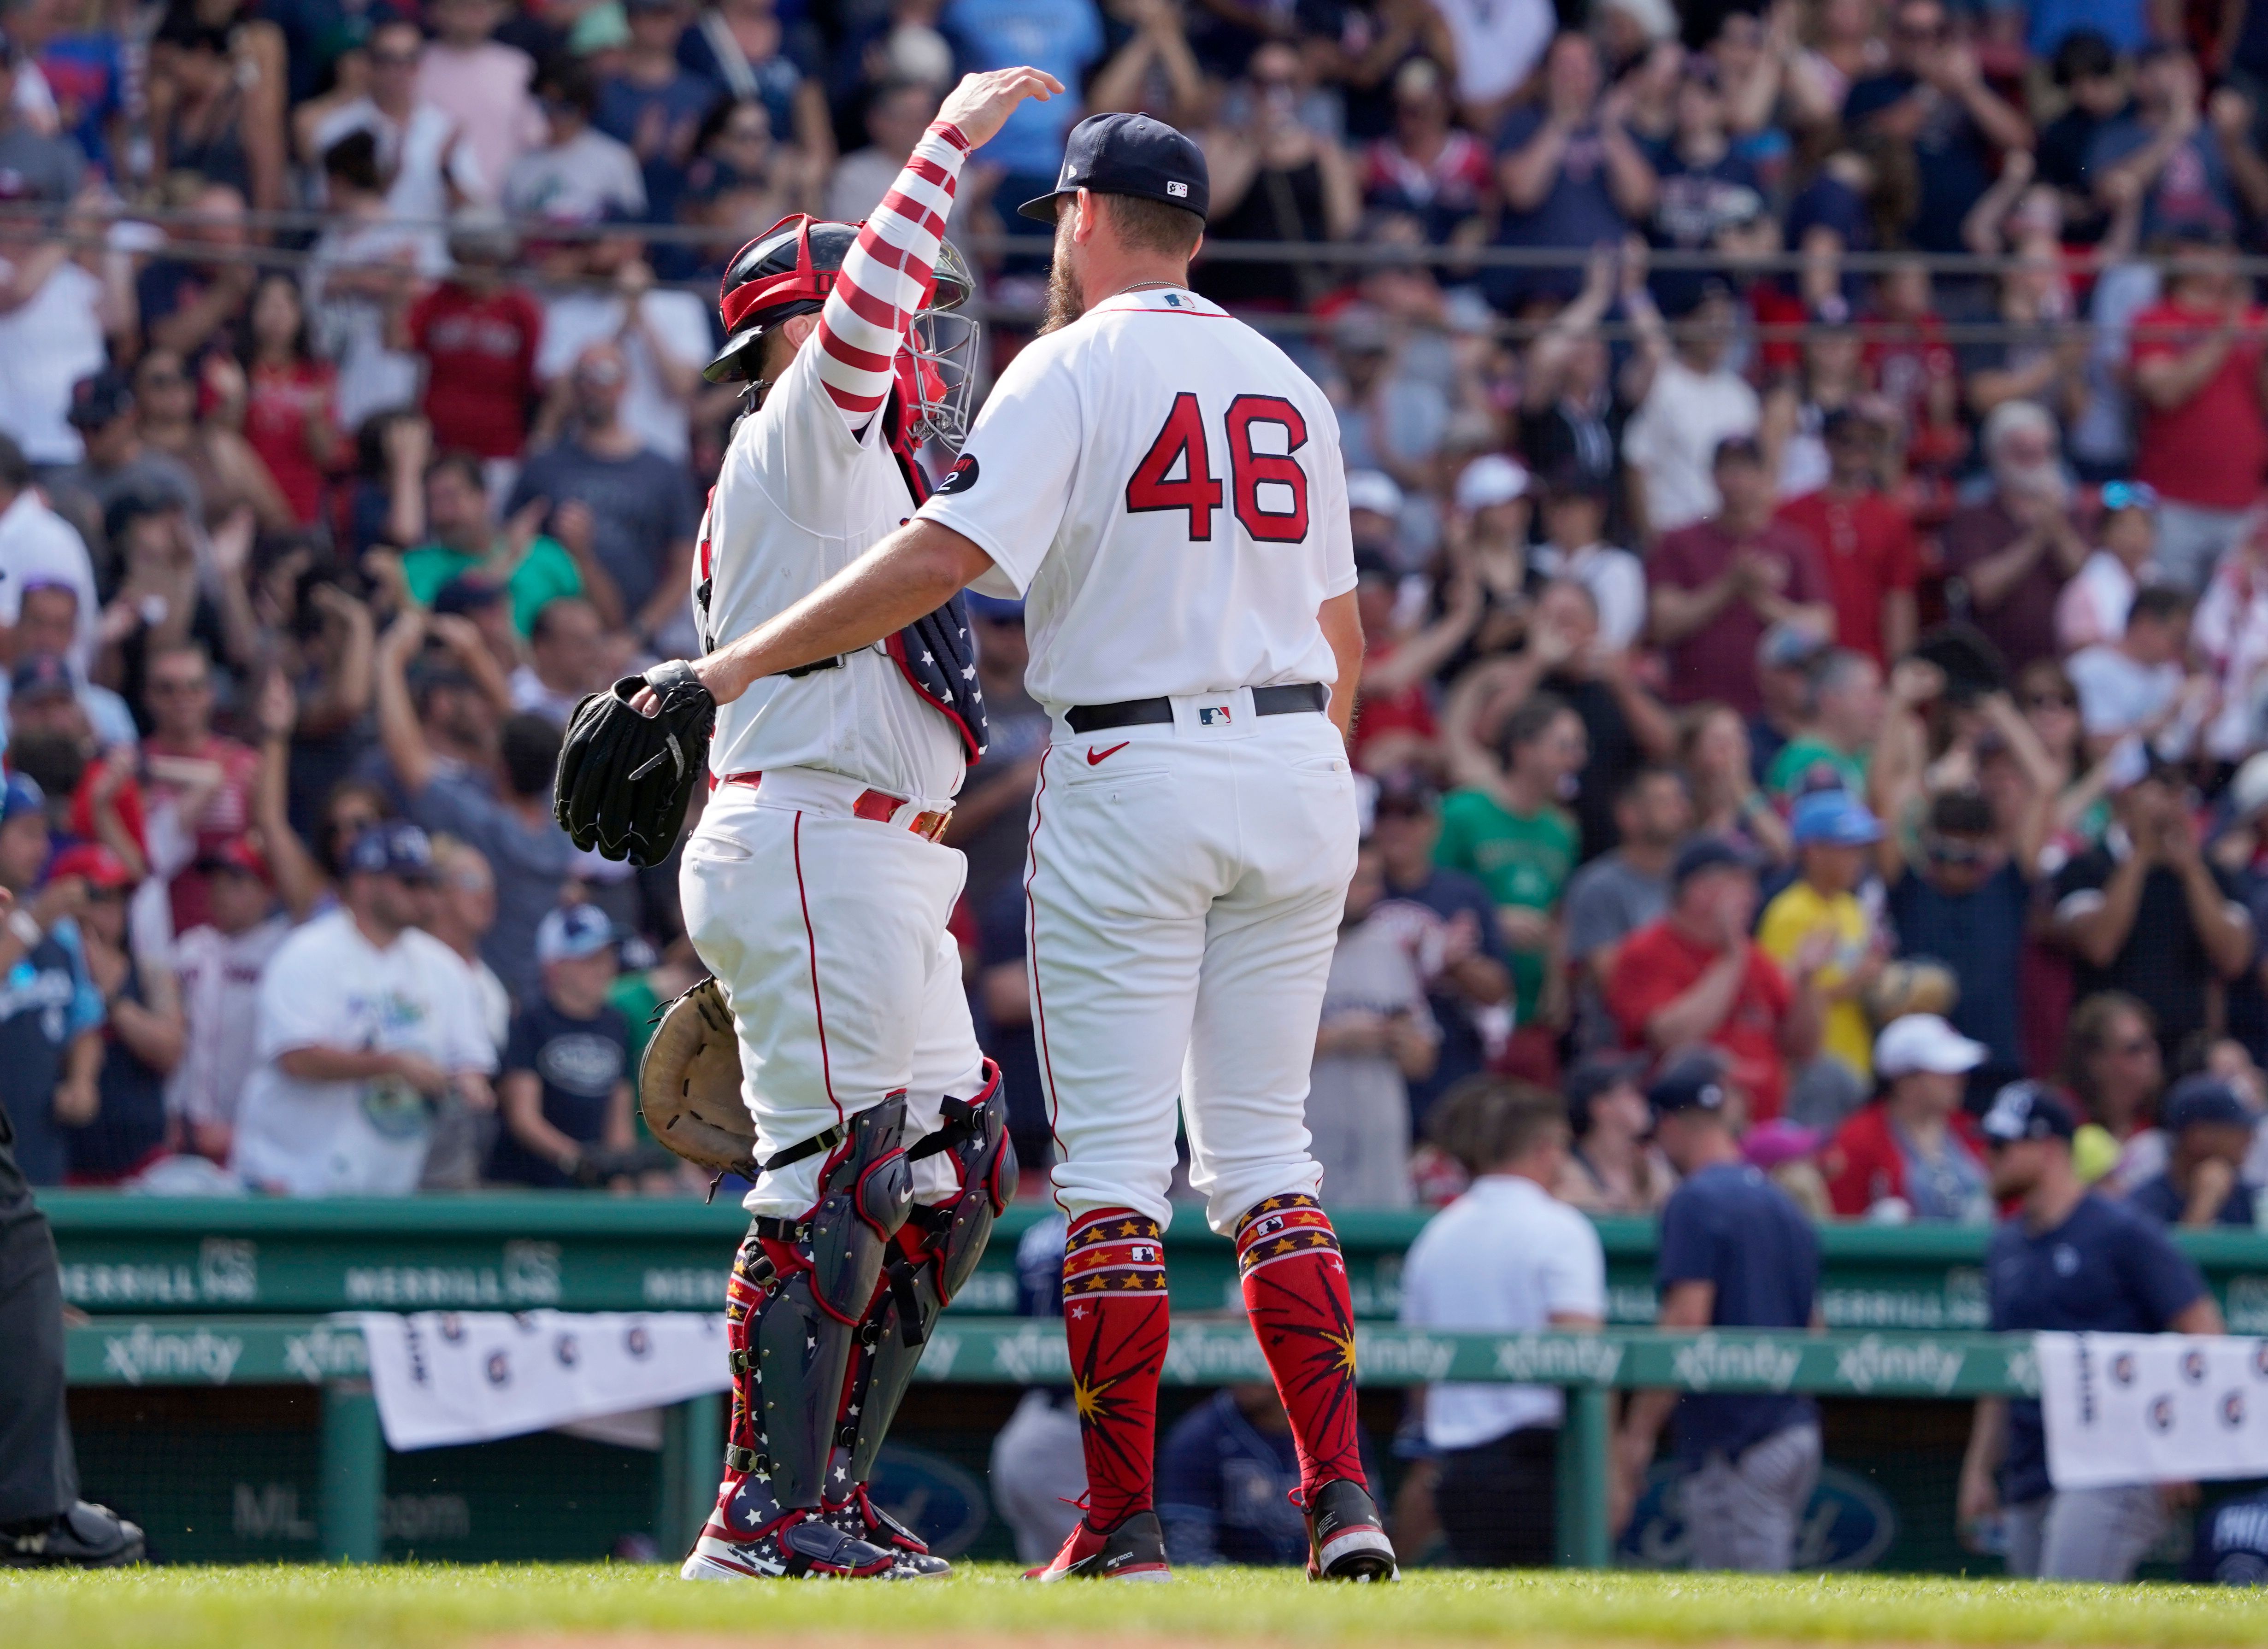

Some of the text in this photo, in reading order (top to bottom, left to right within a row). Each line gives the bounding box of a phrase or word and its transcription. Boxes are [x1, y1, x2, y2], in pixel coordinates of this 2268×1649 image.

[1126, 392, 1308, 544] 46
[346, 1267, 501, 1303] MERRILL
[1821, 1291, 1942, 1328] ERRILL
[105, 1324, 243, 1384] xfinity
[283, 1324, 370, 1384] xfin
[1495, 1329, 1625, 1382] xfinity
[1672, 1331, 1803, 1392] xfinity
[1836, 1332, 1966, 1393] xfinity
